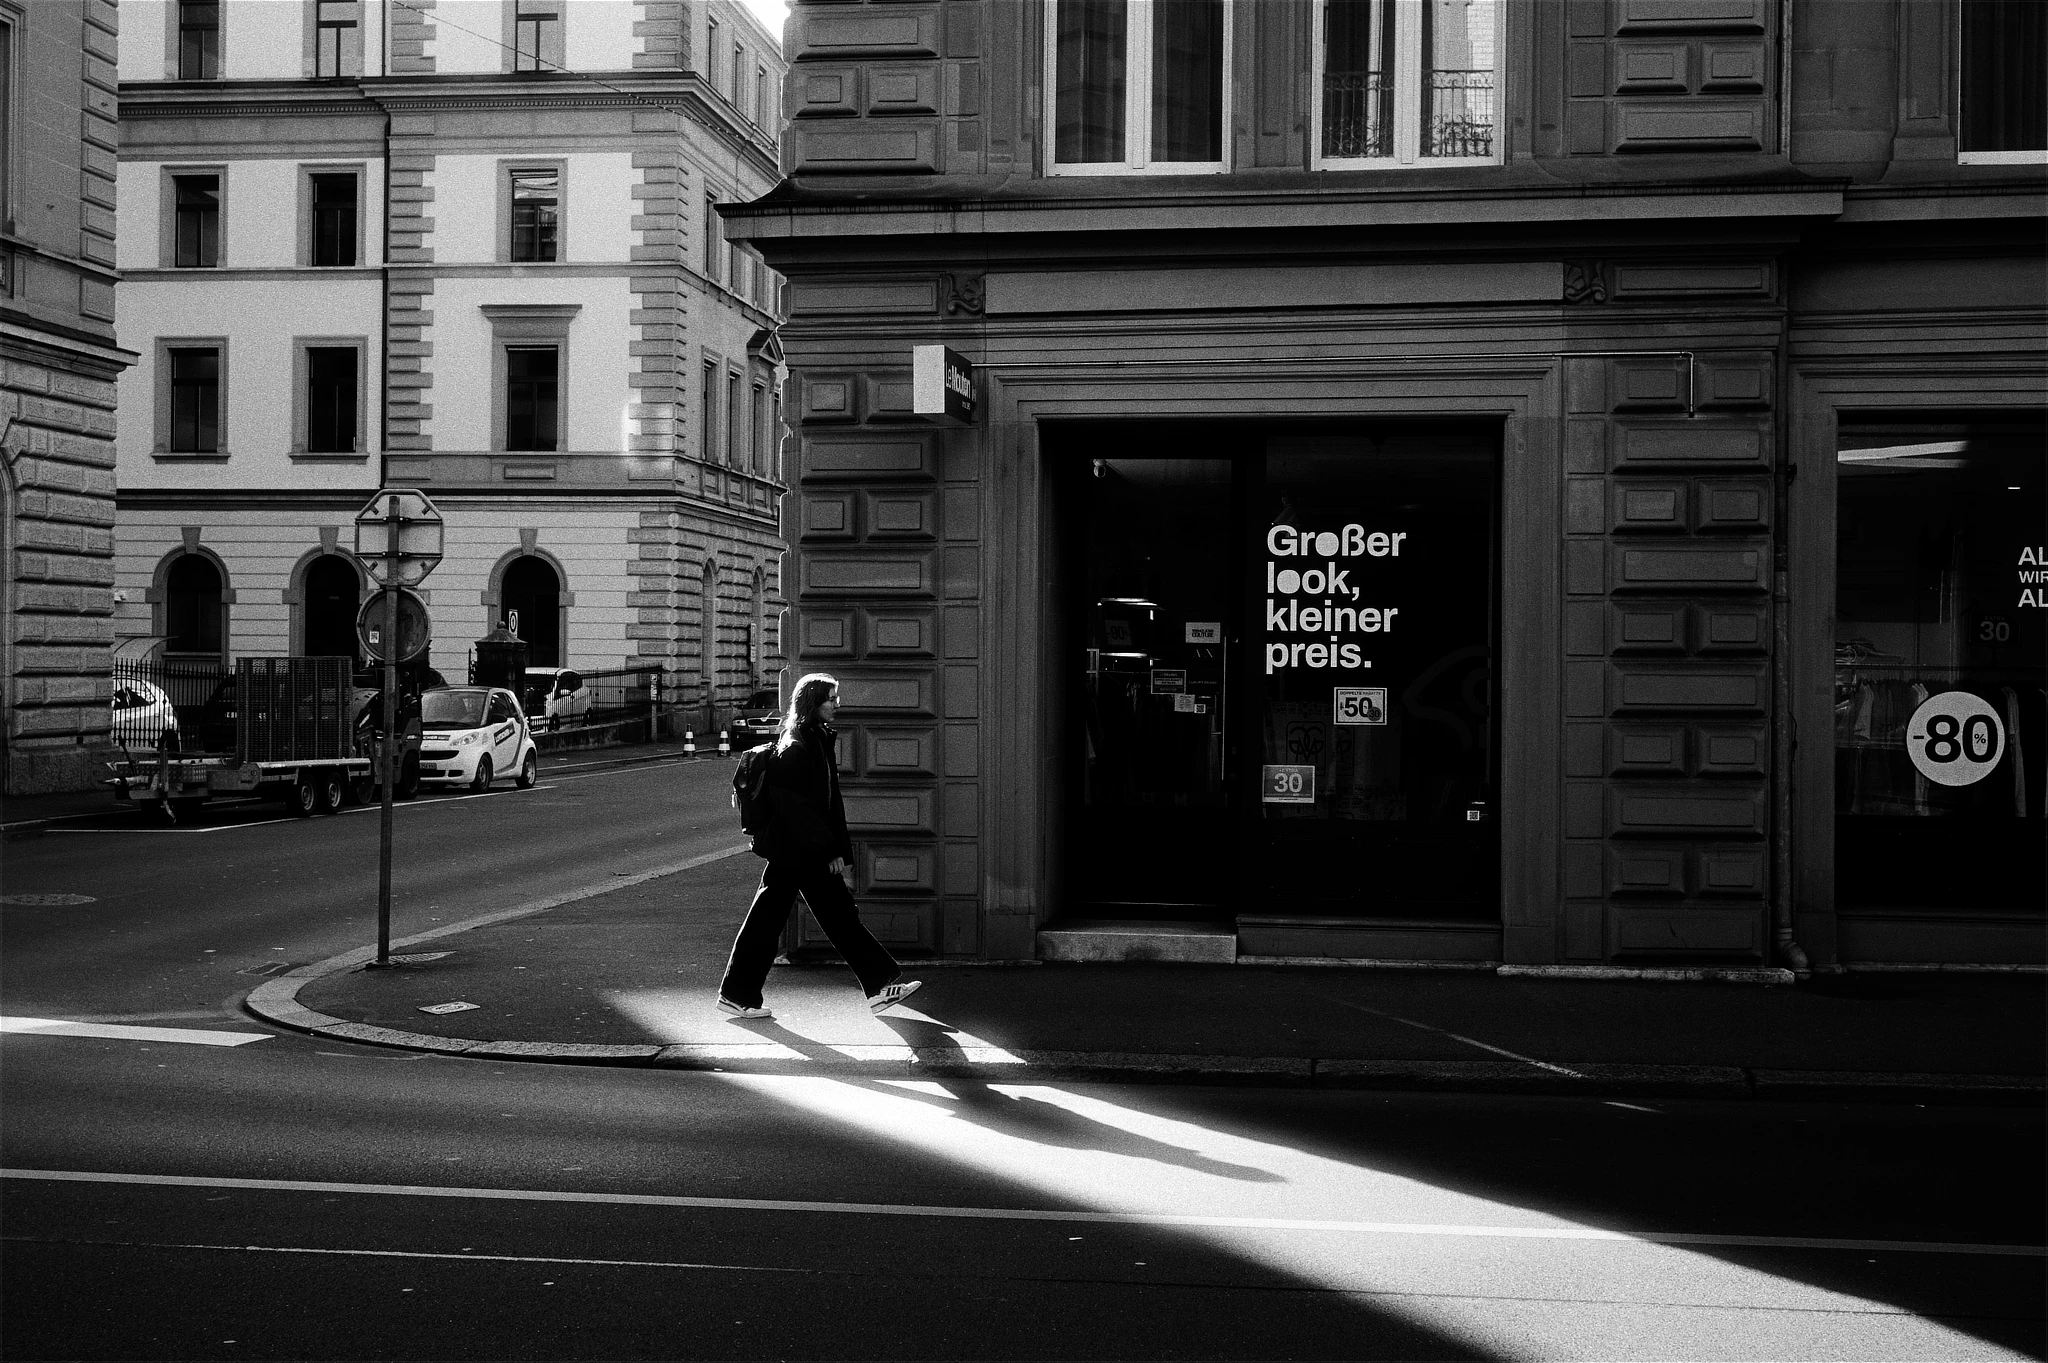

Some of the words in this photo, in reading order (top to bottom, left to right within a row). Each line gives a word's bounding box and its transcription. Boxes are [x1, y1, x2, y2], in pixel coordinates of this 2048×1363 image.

[1267, 524, 1406, 556] Großer
[1267, 561, 1360, 601] look,
[1267, 599, 1398, 632] kleiner
[1266, 636, 1371, 674] preis.
